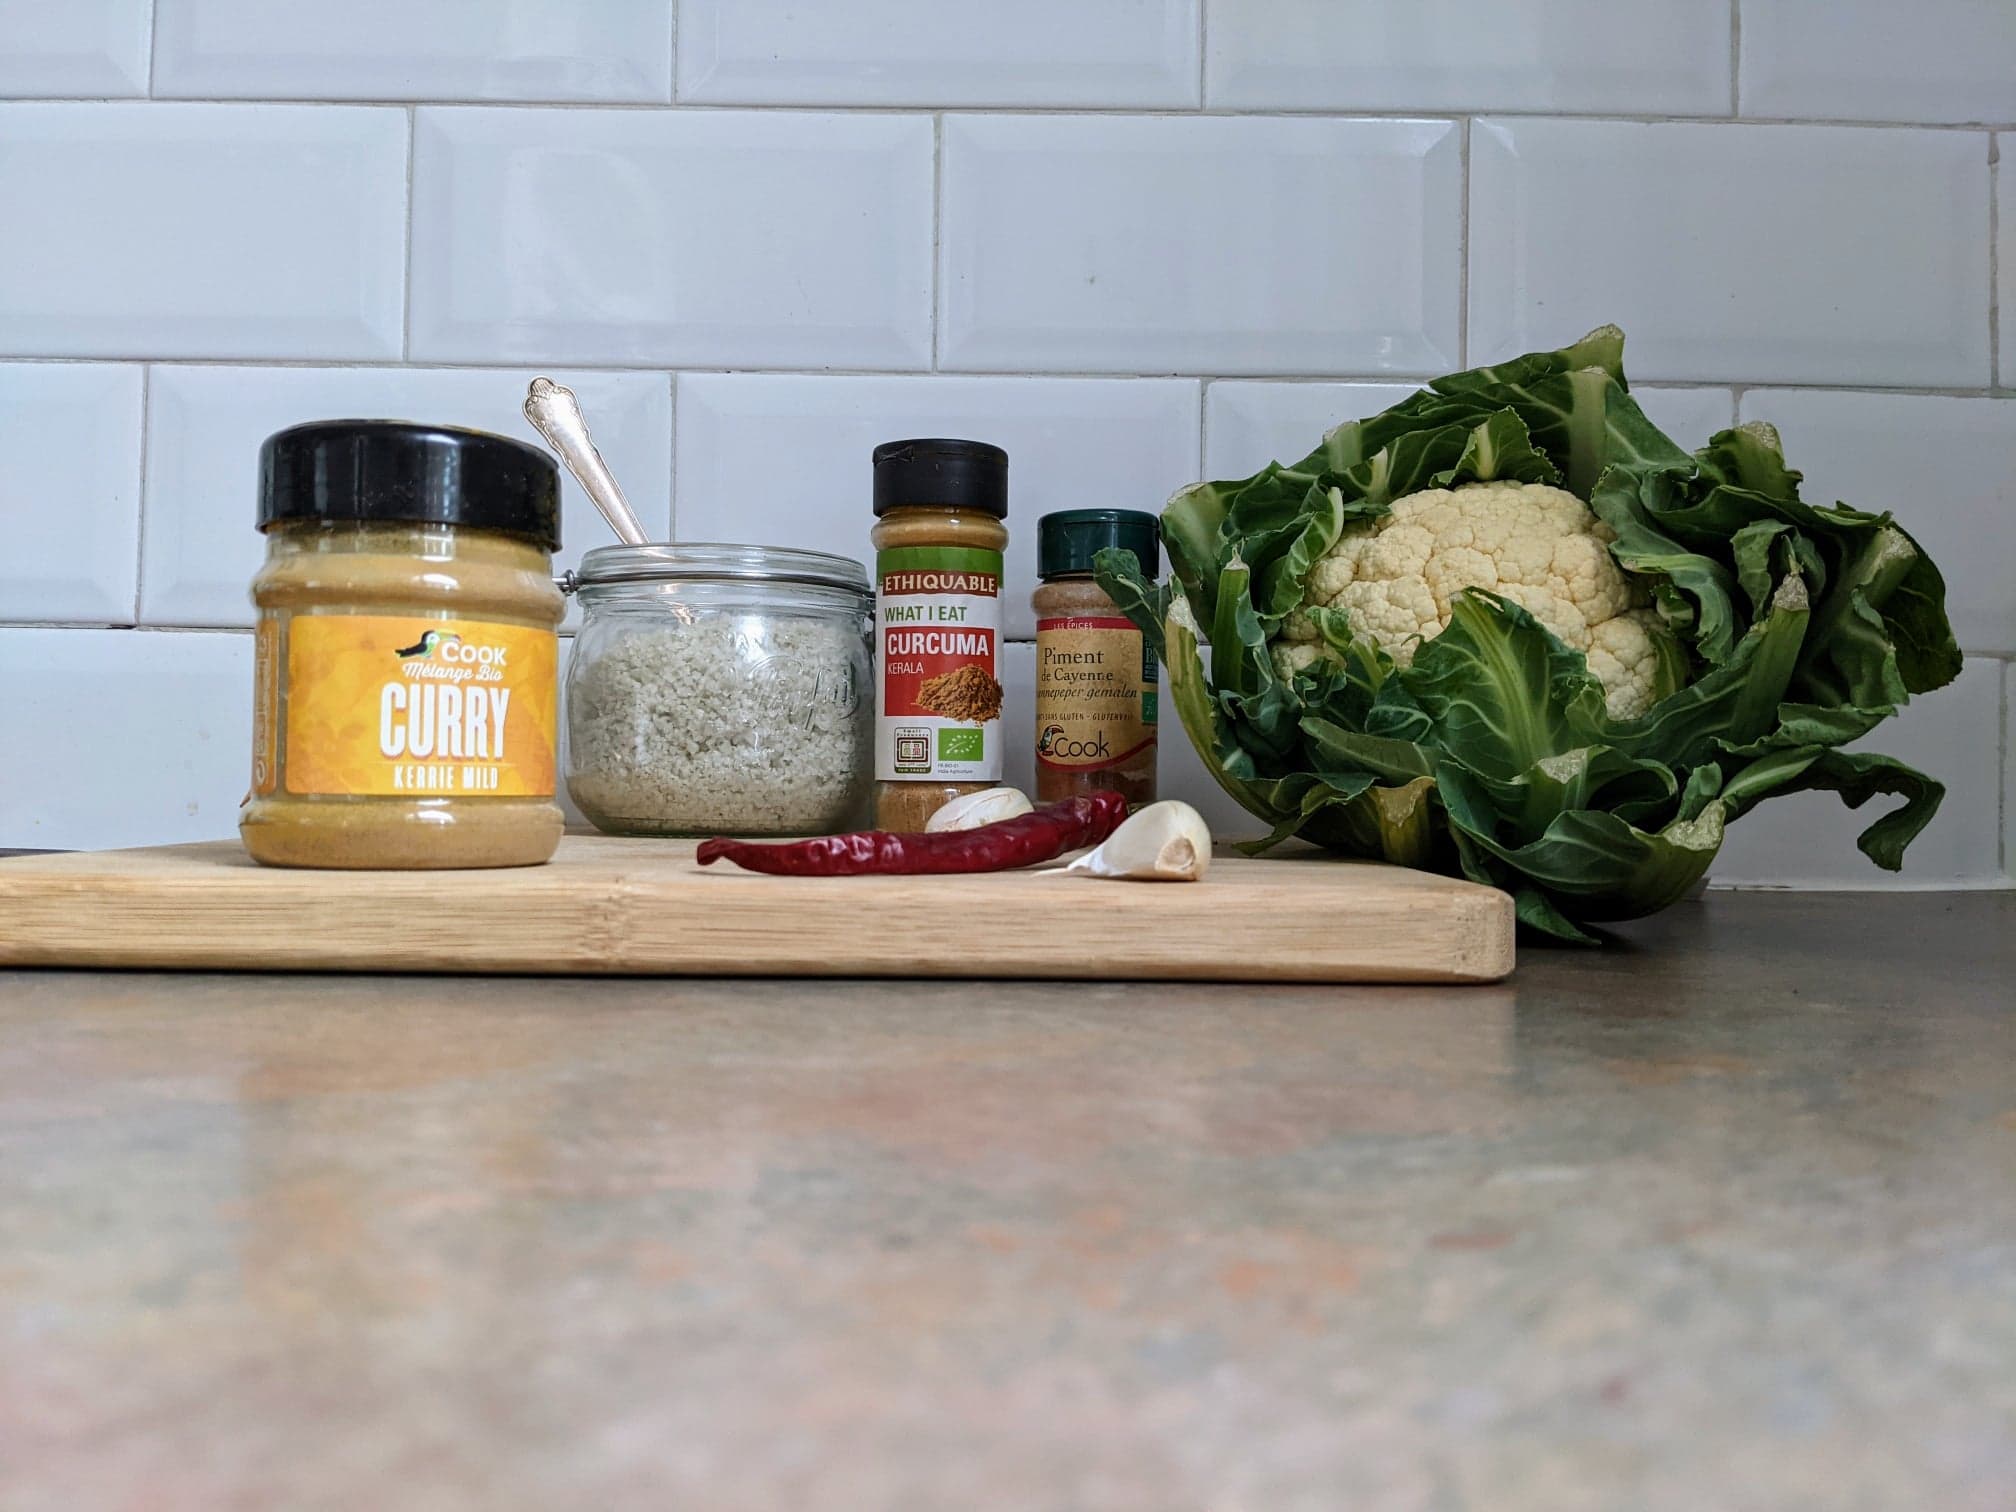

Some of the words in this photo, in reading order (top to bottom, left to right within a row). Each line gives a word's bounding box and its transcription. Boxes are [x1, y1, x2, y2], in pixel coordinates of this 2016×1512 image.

[885, 574, 995, 592] ETHIQUABLE
[885, 606, 923, 622] WHAT
[928, 606, 933, 620] I
[939, 606, 967, 621] EAT
[887, 632, 989, 656] CURCUMA
[441, 641, 507, 666] COOK
[1044, 648, 1104, 665] Piment
[402, 662, 474, 684] Mélange
[476, 664, 504, 682] Bio
[887, 662, 924, 674] KERALA
[1041, 669, 1051, 682] de
[1054, 668, 1113, 685] Cayenne
[1085, 684, 1137, 701] gemalen
[380, 682, 511, 759] CURRY
[1059, 713, 1084, 721] GLUTEN
[1054, 731, 1110, 757] Cook
[394, 766, 454, 789] KERRIE
[462, 767, 498, 790] MILD
